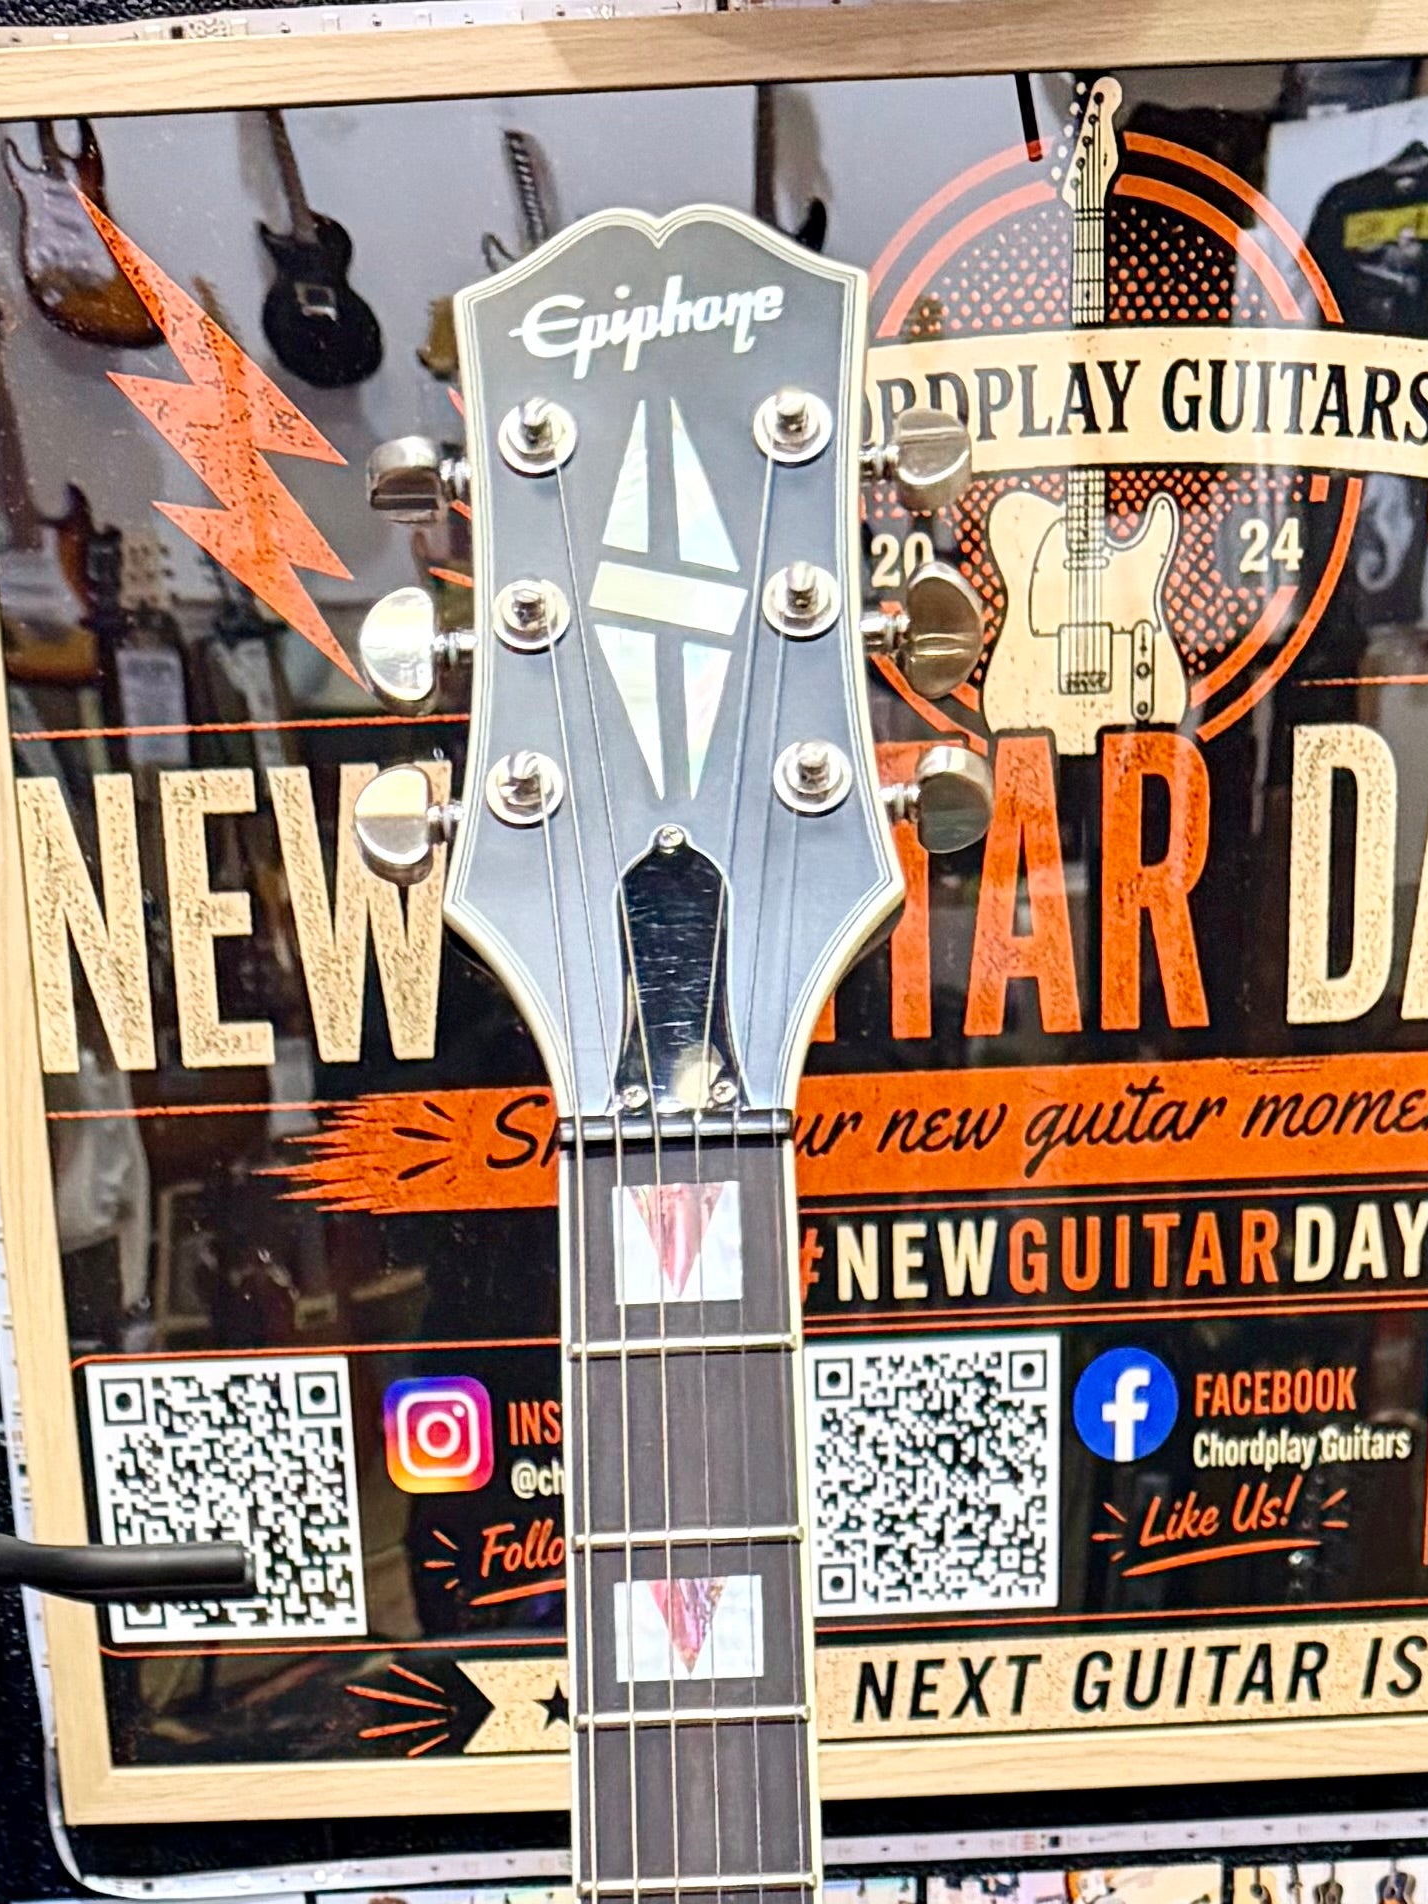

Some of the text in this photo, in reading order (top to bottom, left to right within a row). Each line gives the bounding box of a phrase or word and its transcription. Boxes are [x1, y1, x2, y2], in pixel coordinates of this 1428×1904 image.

[508, 274, 785, 380] Epiphone
[863, 358, 1142, 450] RDPLAY
[870, 531, 935, 588] 20
[1240, 517, 1305, 575] 24
[18, 760, 447, 1074] NEW
[877, 1105, 1008, 1154] new
[1024, 1077, 1229, 1178] guitar
[1194, 1365, 1357, 1418] FACEBOOK
[1192, 1424, 1413, 1473] Chordplay Guitars
[479, 1517, 565, 1579] Follo
[1138, 1473, 1304, 1548] Like Us!
[853, 1653, 1042, 1724] NEXT
[1071, 1638, 1330, 1714] GUITAR
[1360, 1634, 1427, 1700] IS
